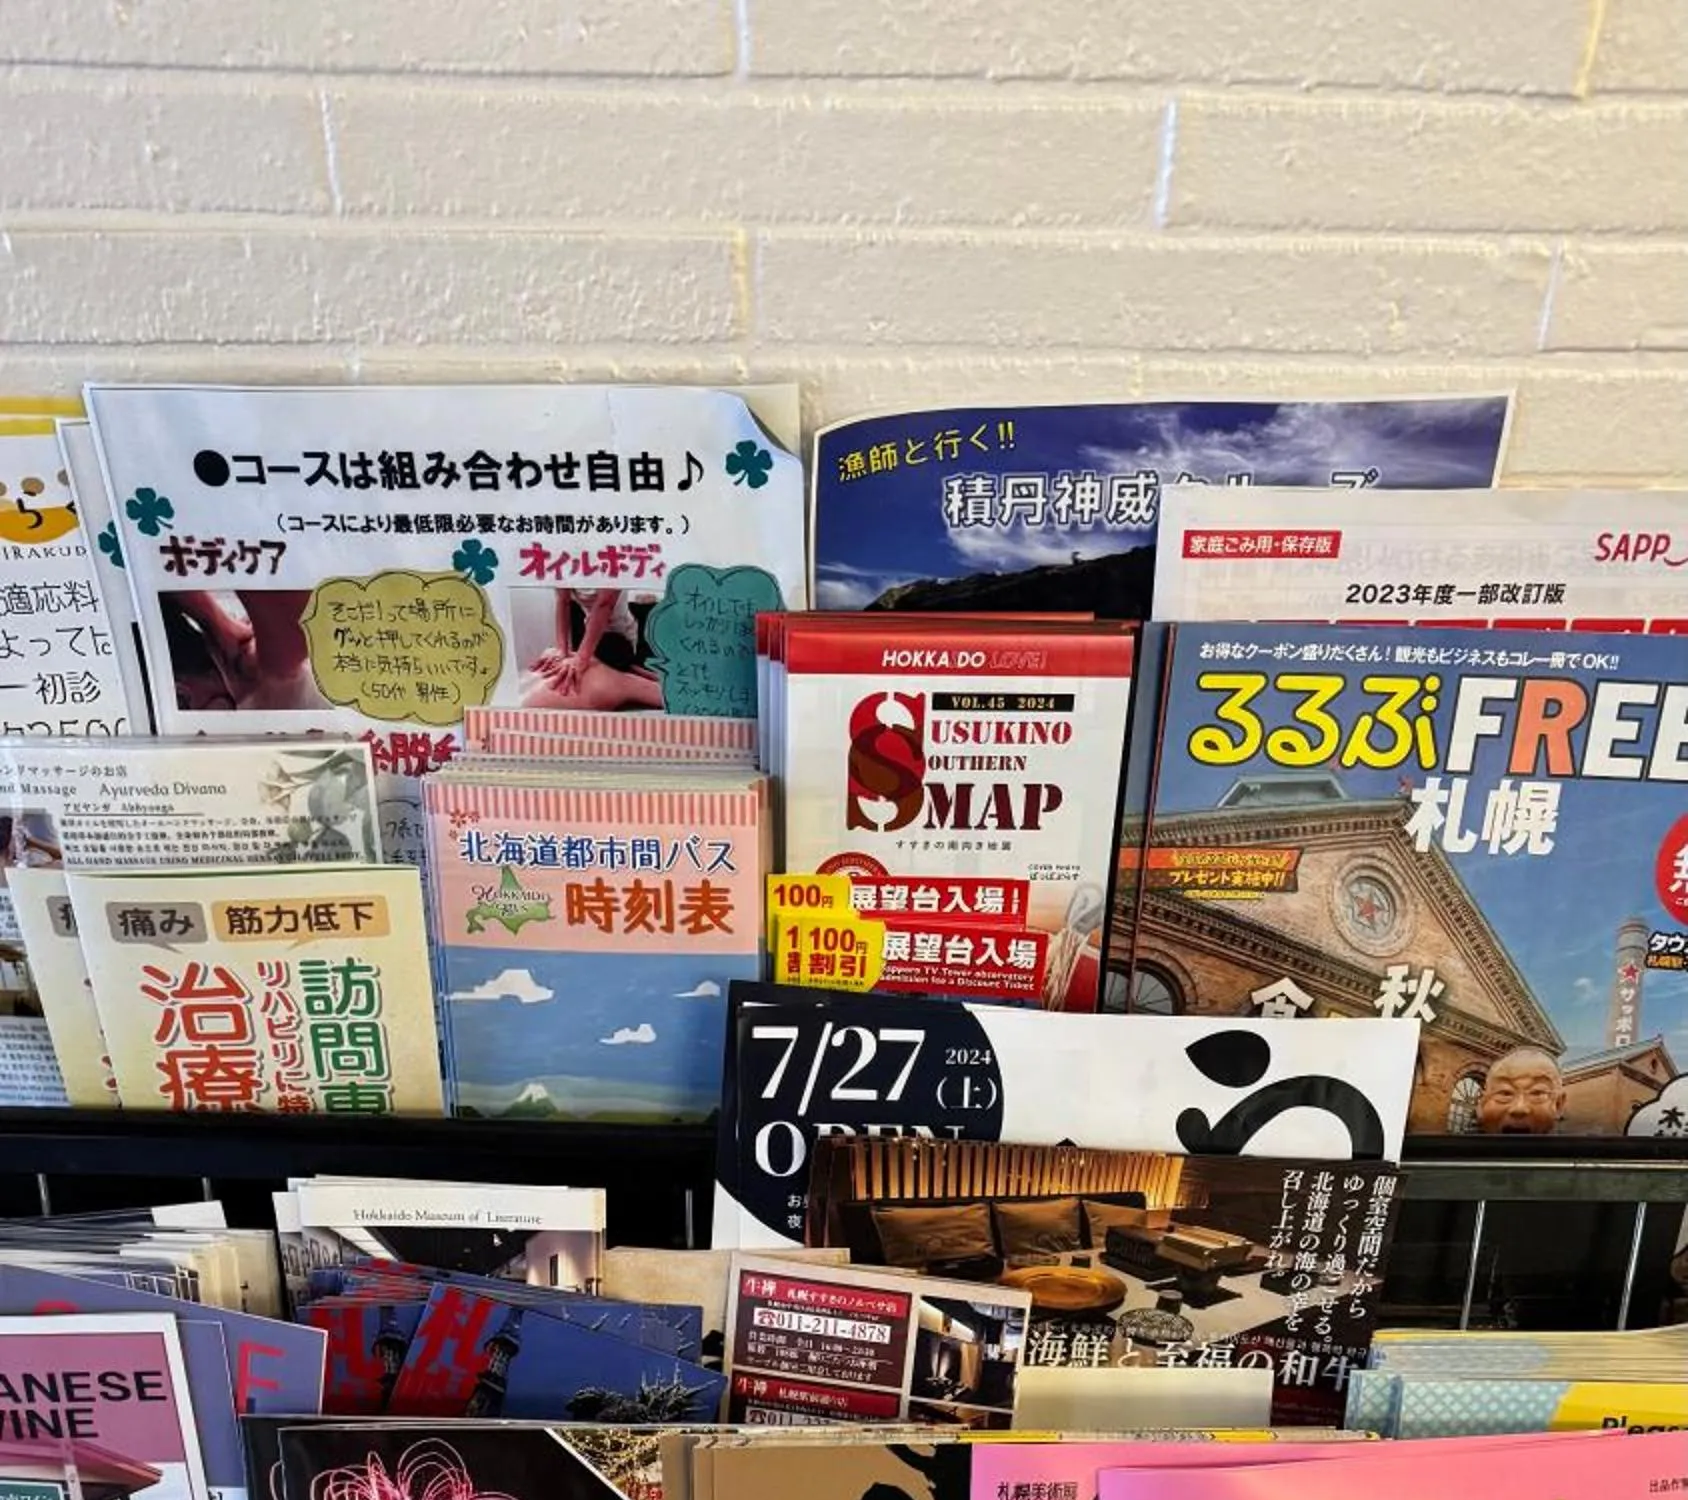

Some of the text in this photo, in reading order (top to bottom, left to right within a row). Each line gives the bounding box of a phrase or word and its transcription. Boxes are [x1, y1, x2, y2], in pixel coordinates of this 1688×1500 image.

[159, 534, 287, 578] ボディケア
[518, 541, 667, 582] オイルボディ
[1189, 533, 1333, 557] 家庭ごみ用・保存版
[1345, 583, 1566, 607] 2023年度一部改訂版
[1017, 696, 1056, 710] 2024
[1187, 673, 1442, 770] るるぶ
[922, 782, 1064, 831] MAP
[1403, 776, 1562, 856] 札幌
[458, 829, 738, 874] 北海道都市間バス
[564, 876, 736, 936] 時刻表
[773, 883, 834, 909] 100円
[117, 906, 195, 938] 痛み
[226, 902, 376, 936] 筋力低下
[807, 950, 867, 979] 割引
[881, 930, 1039, 970] 展望台入場
[752, 1021, 926, 1117] 7/27
[944, 1047, 993, 1067] 2024
[353, 1209, 411, 1221] Hokkaido
[415, 1210, 465, 1222] Museum
[469, 1211, 480, 1222] of
